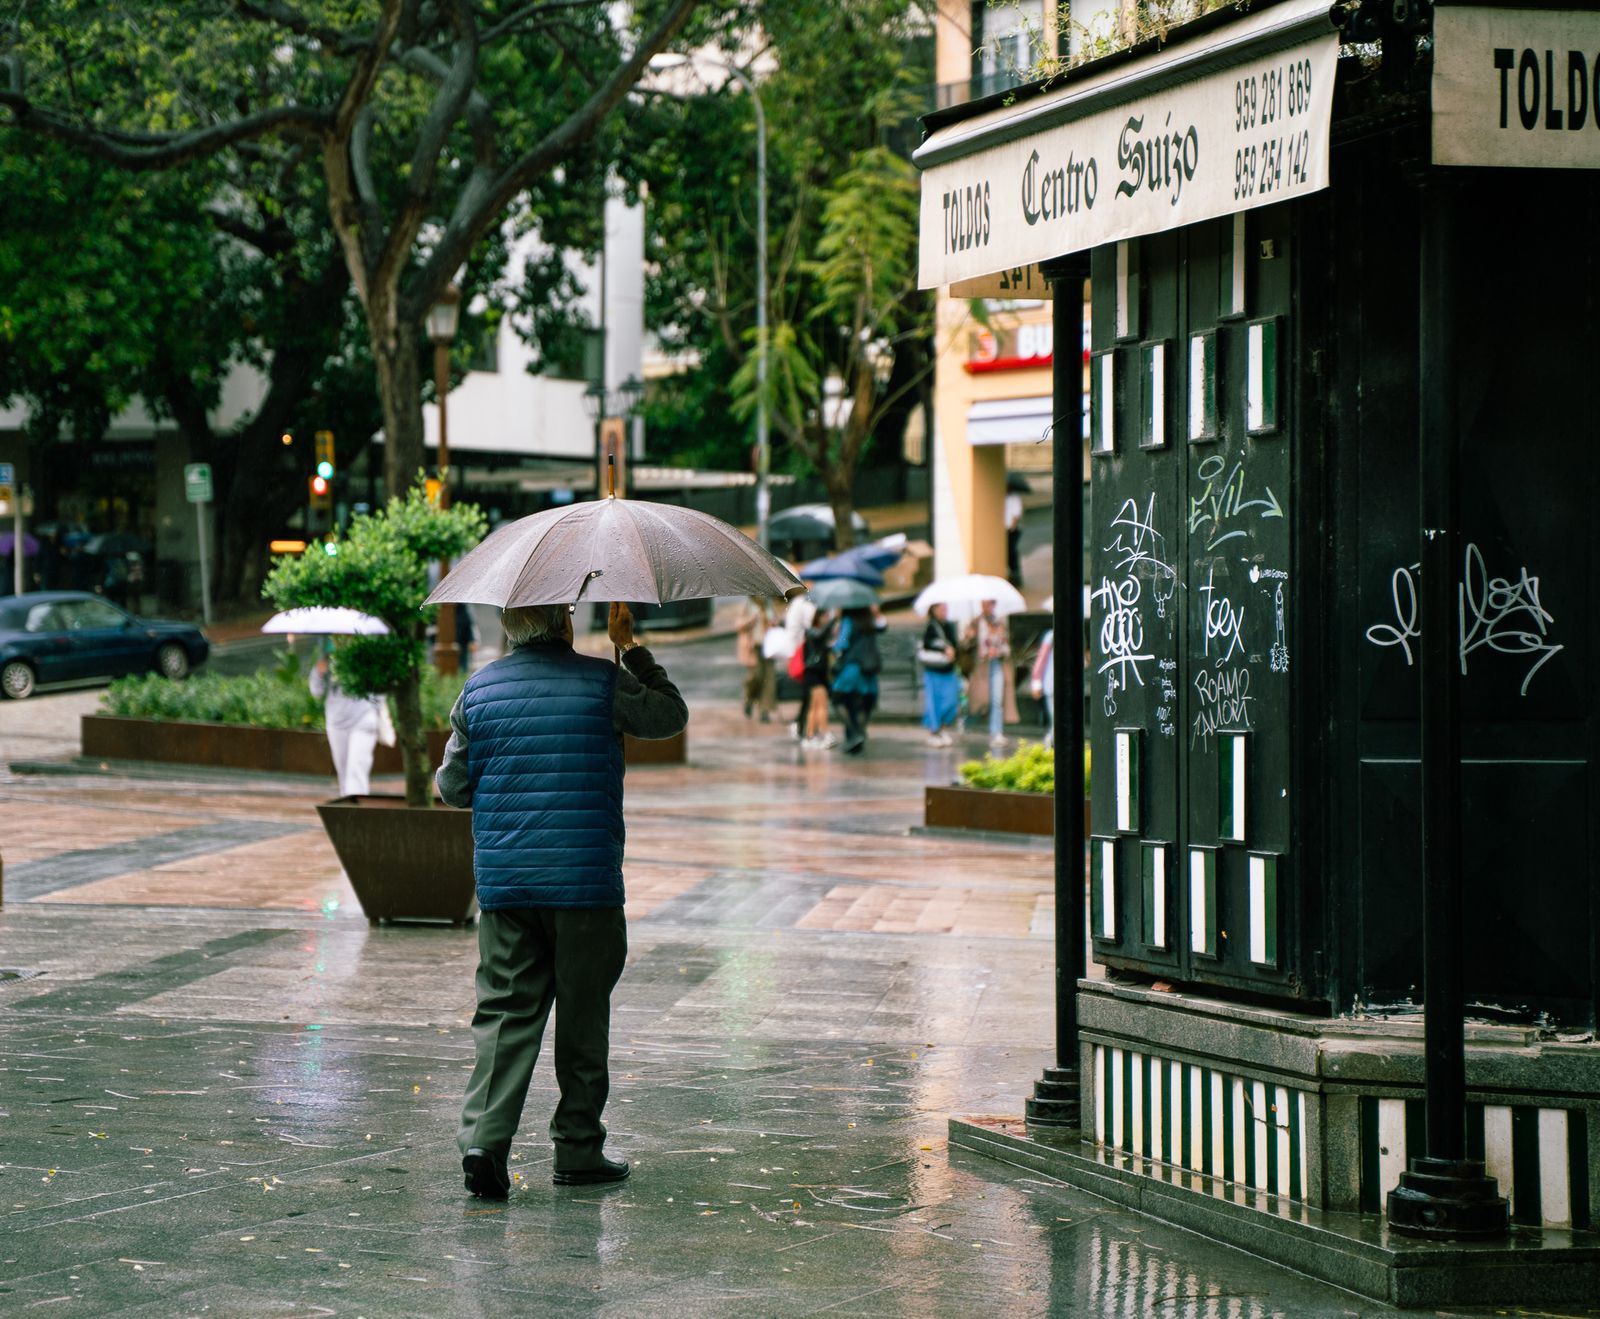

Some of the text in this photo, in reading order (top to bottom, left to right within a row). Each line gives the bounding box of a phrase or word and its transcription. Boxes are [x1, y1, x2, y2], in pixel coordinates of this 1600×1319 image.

[1235, 58, 1312, 132] 959 281 869
[943, 180, 990, 255] TOLDOS
[1022, 149, 1098, 226] Centro
[1234, 129, 1309, 201] 959 254 142
